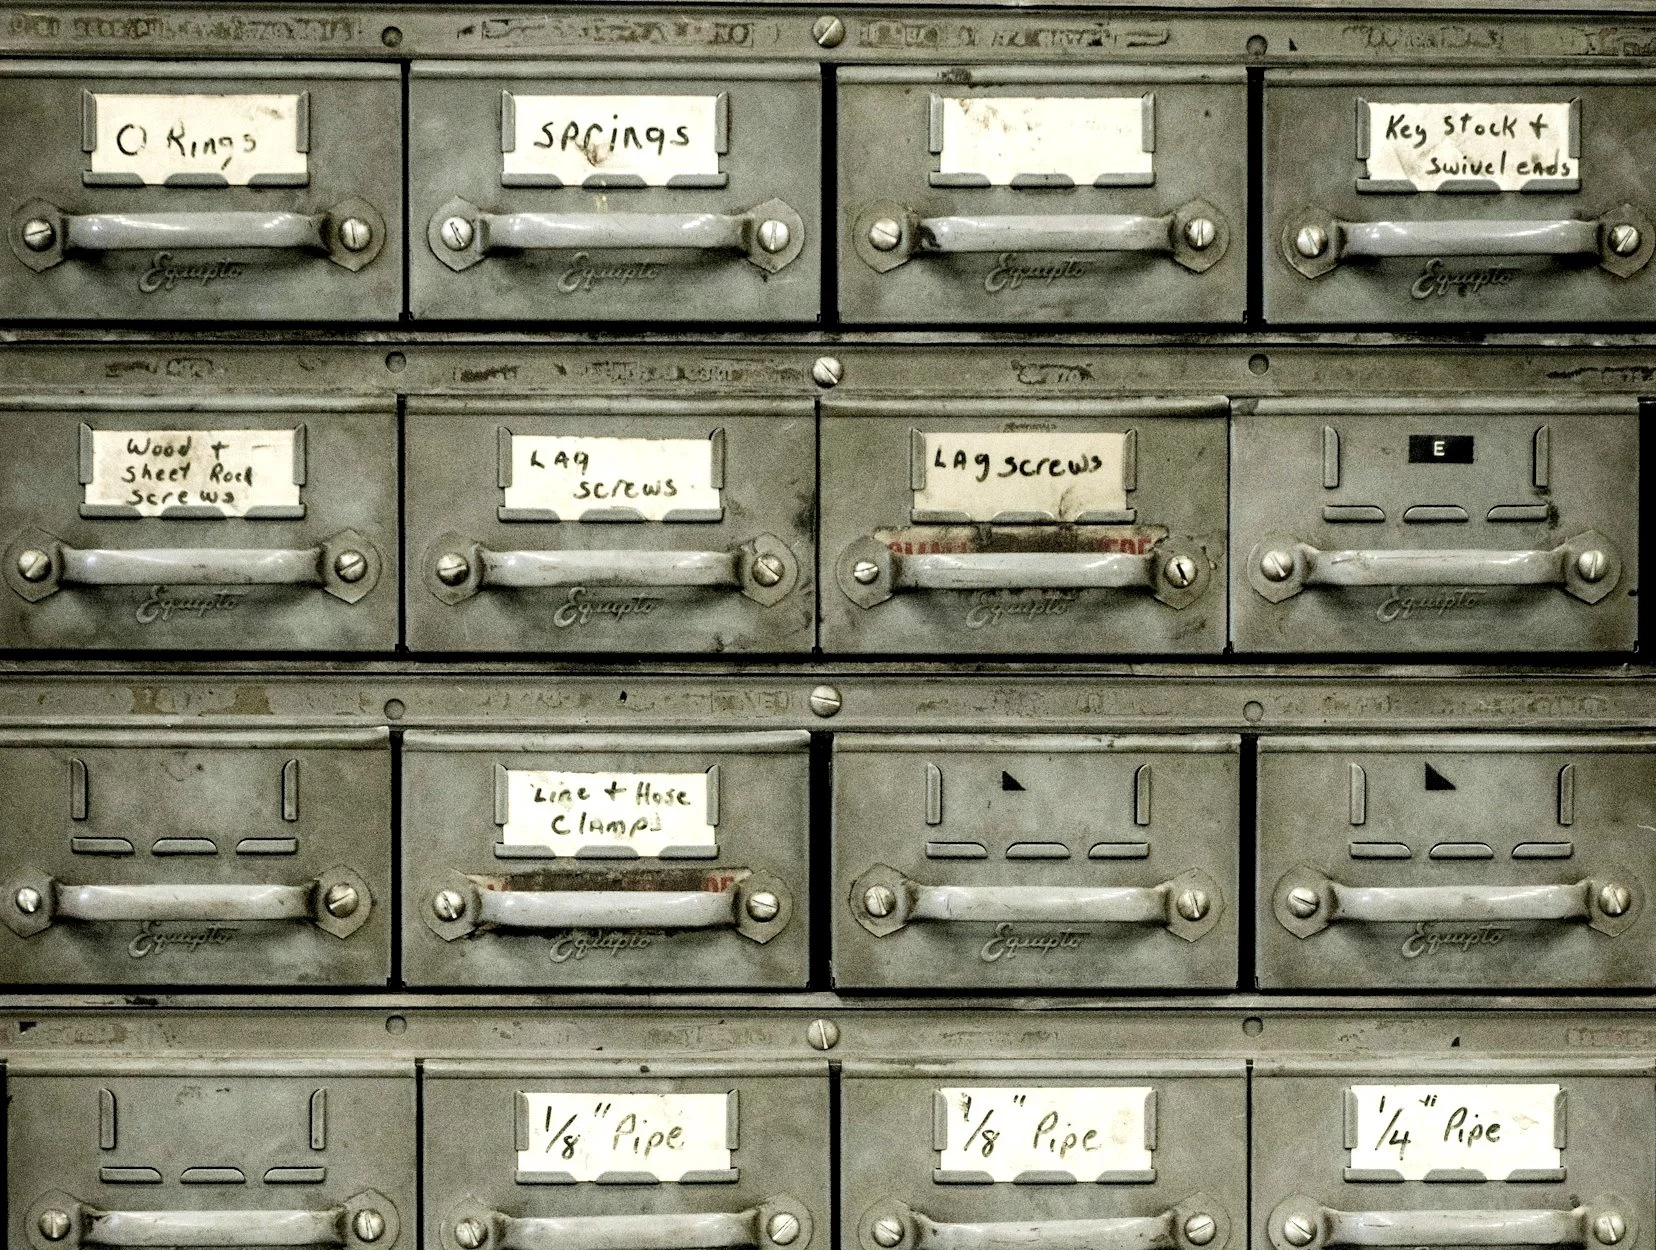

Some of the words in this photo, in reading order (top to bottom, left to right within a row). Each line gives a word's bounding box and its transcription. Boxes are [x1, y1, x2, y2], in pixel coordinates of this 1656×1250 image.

[116, 123, 148, 156] O
[1385, 113, 1428, 149] Key
[1516, 148, 1571, 177] ends
[126, 435, 193, 457] Wood
[1433, 440, 1445, 456] E
[612, 1112, 685, 1158] Pipe
[1032, 1110, 1101, 1159] Pipe
[1443, 1106, 1501, 1148] Pipe
